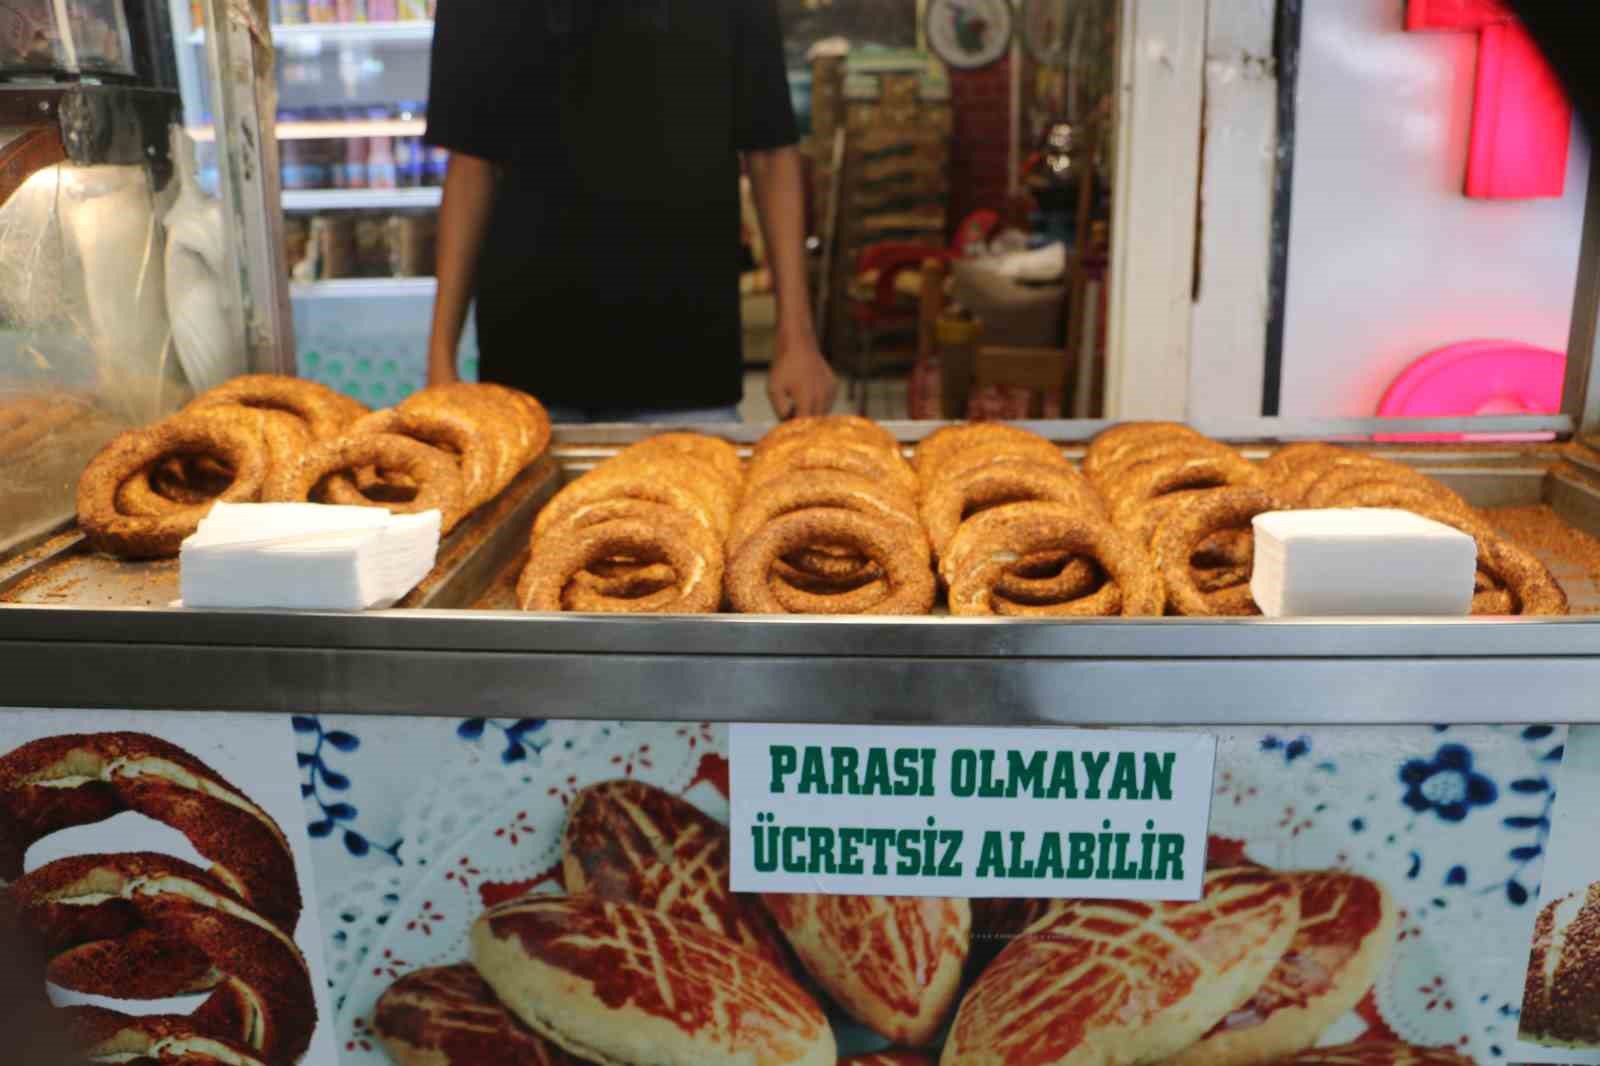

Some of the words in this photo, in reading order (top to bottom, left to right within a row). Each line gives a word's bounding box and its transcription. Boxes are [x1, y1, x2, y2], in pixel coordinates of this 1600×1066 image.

[769, 744, 937, 798] PARASI
[949, 748, 1177, 801] OLMAYAN
[751, 812, 964, 878] ÜCRETSİZ
[975, 818, 1185, 881] ALABİLİR
